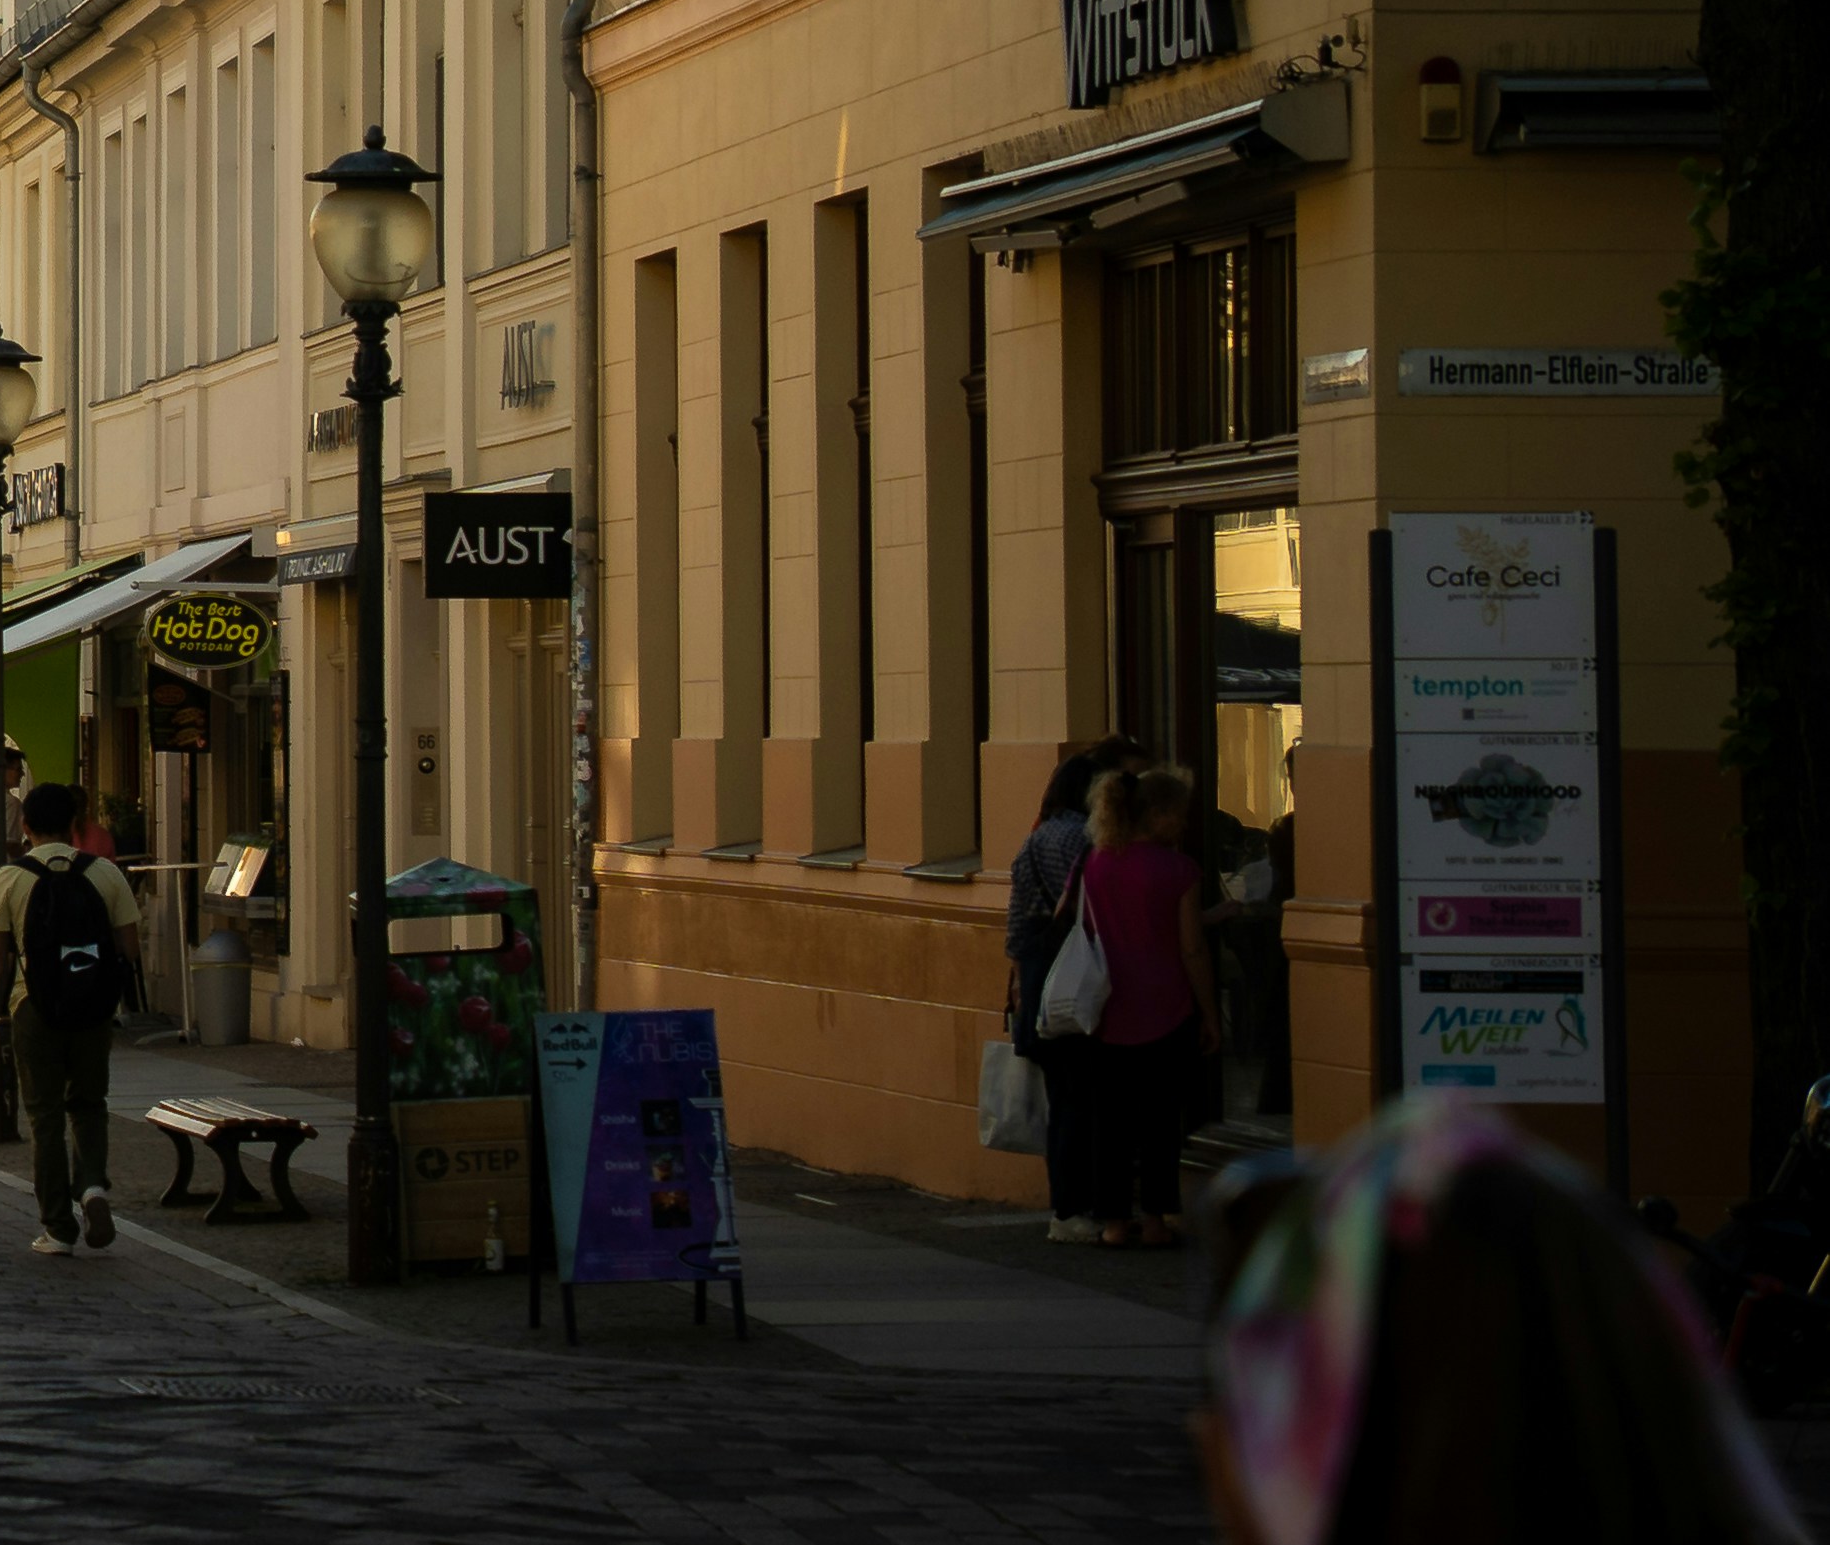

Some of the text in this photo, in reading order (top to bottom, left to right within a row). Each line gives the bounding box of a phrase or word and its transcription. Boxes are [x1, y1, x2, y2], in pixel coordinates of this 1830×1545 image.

[1429, 355, 1708, 385] Hermann-Elflein-Straße
[444, 525, 556, 565] AUST
[1426, 564, 1561, 587] Cafe Ceci
[178, 601, 242, 617] The Best
[152, 616, 259, 657] Hot Dog
[179, 642, 234, 652] POTSDAM
[1412, 674, 1524, 700] tempton
[417, 734, 436, 750] 66
[1414, 784, 1582, 800] NEIGHBOURHOOD
[637, 1021, 682, 1041] THE
[1419, 1005, 1546, 1035] MEILEN
[1440, 1027, 1529, 1055] WEIT
[454, 1148, 520, 1174] STEP
[604, 1159, 642, 1171] Drinks
